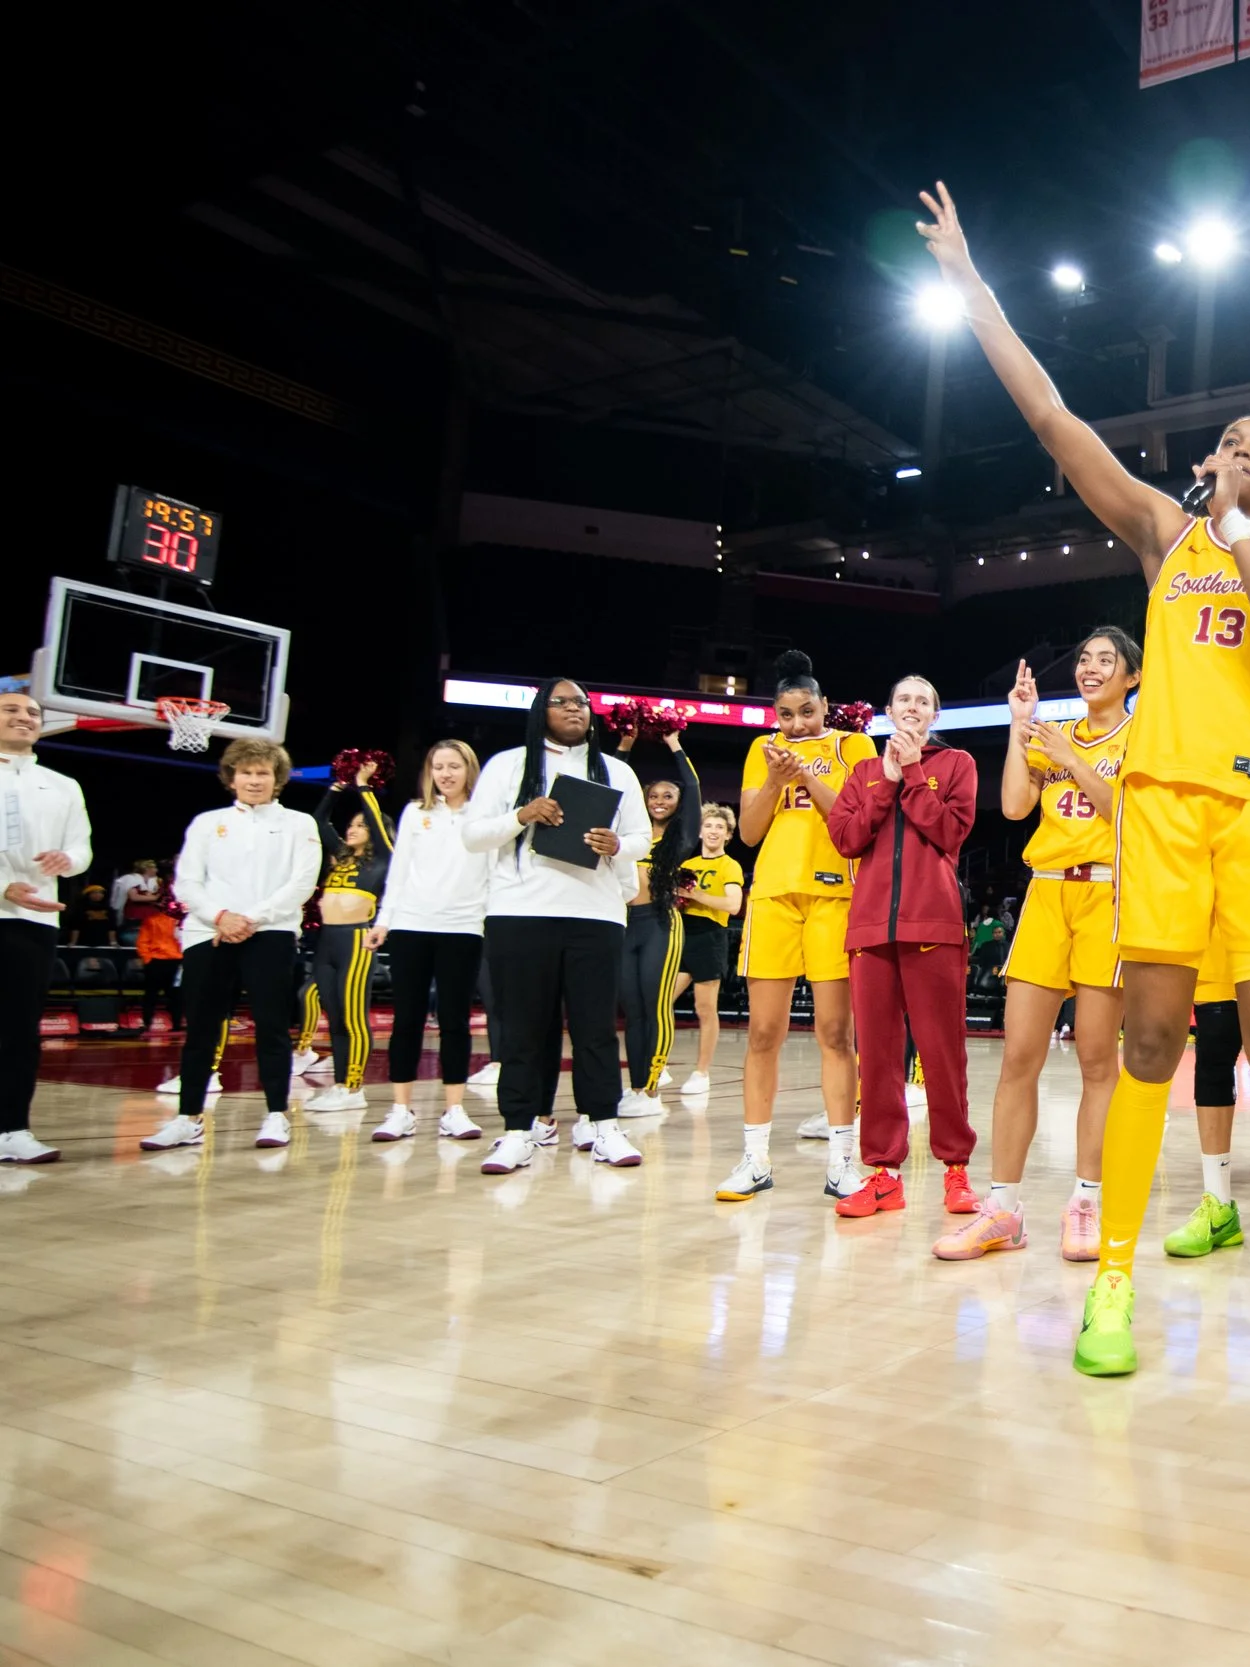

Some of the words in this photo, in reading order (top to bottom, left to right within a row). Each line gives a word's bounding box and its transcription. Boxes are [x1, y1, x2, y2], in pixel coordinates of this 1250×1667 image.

[1148, 10, 1168, 31] 33
[143, 499, 213, 536] 19:57
[142, 522, 199, 572] 30
[1193, 605, 1247, 649] 13
[812, 757, 832, 777] Cal
[784, 786, 811, 810] 12
[1055, 789, 1097, 821] 45
